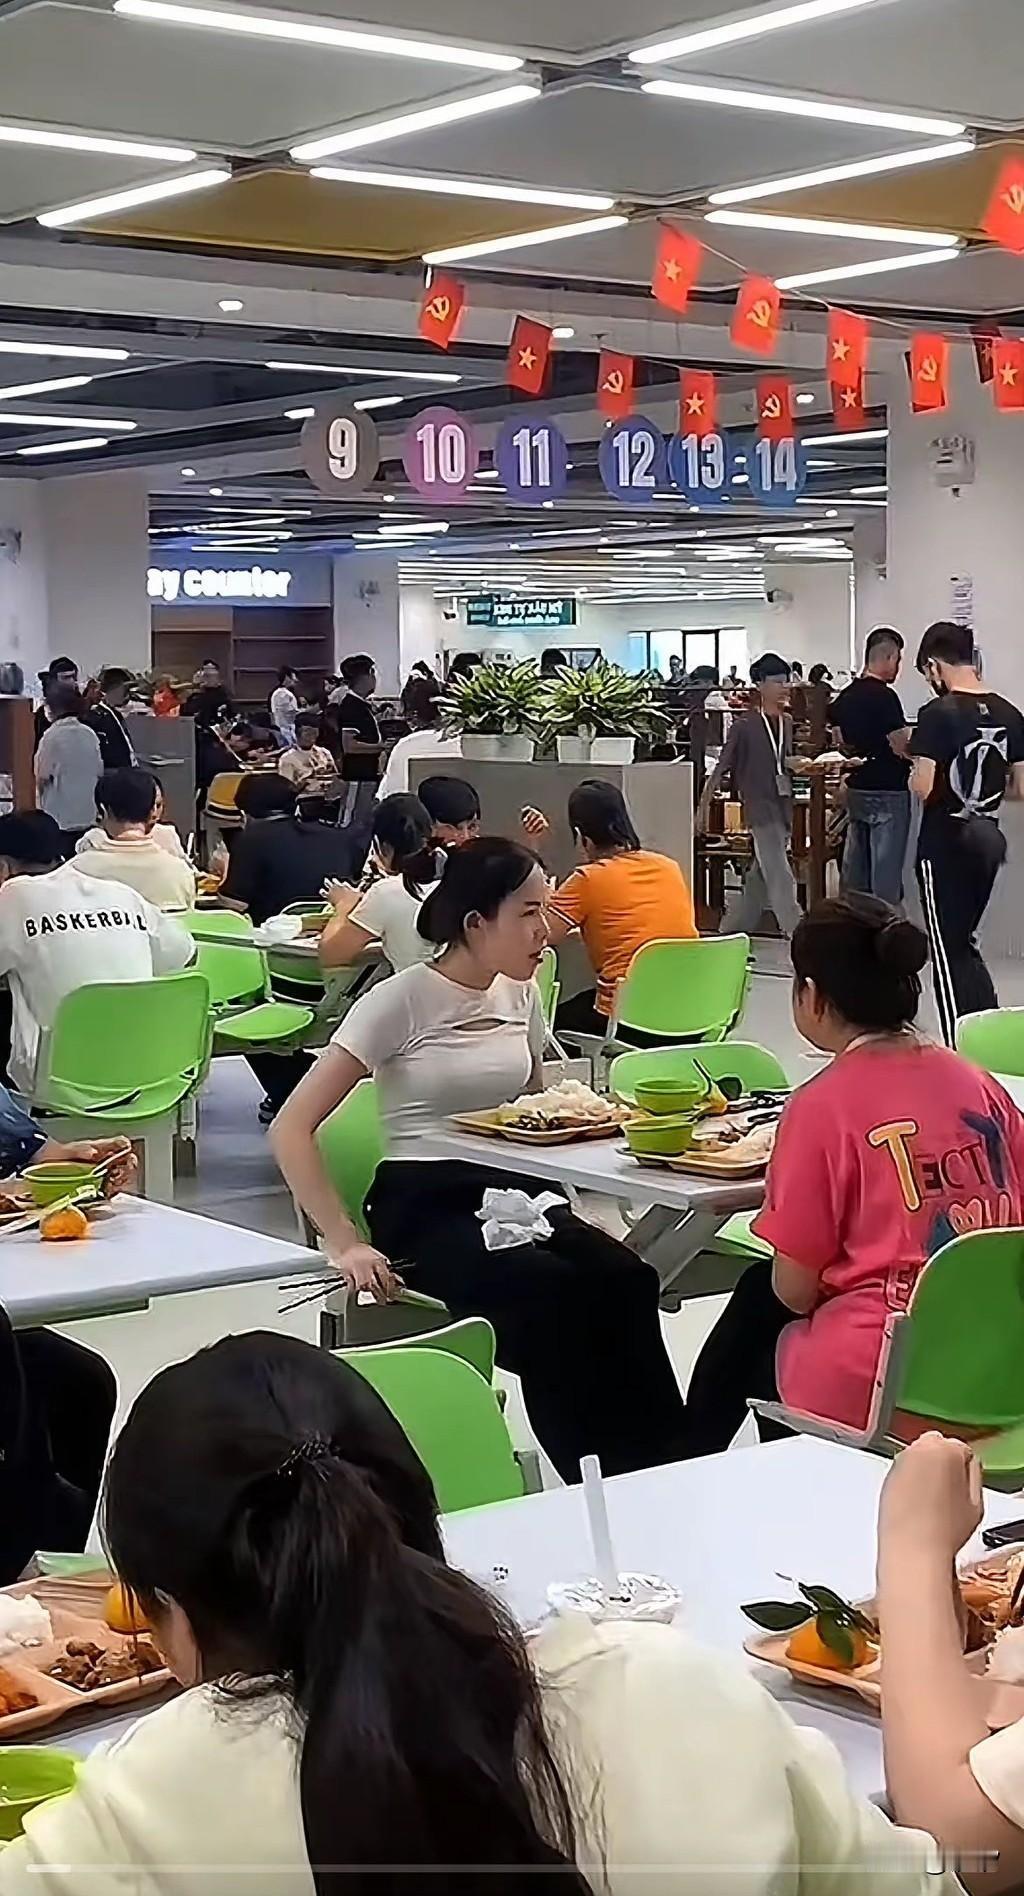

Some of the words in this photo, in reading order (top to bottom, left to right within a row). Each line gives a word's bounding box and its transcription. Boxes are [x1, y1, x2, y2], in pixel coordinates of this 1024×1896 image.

[328, 417, 357, 480] 9
[416, 423, 466, 483] 10
[512, 428, 551, 487] 11
[612, 431, 656, 487] 12
[681, 432, 725, 489] 13
[755, 436, 797, 491] 14
[183, 565, 292, 598] counter
